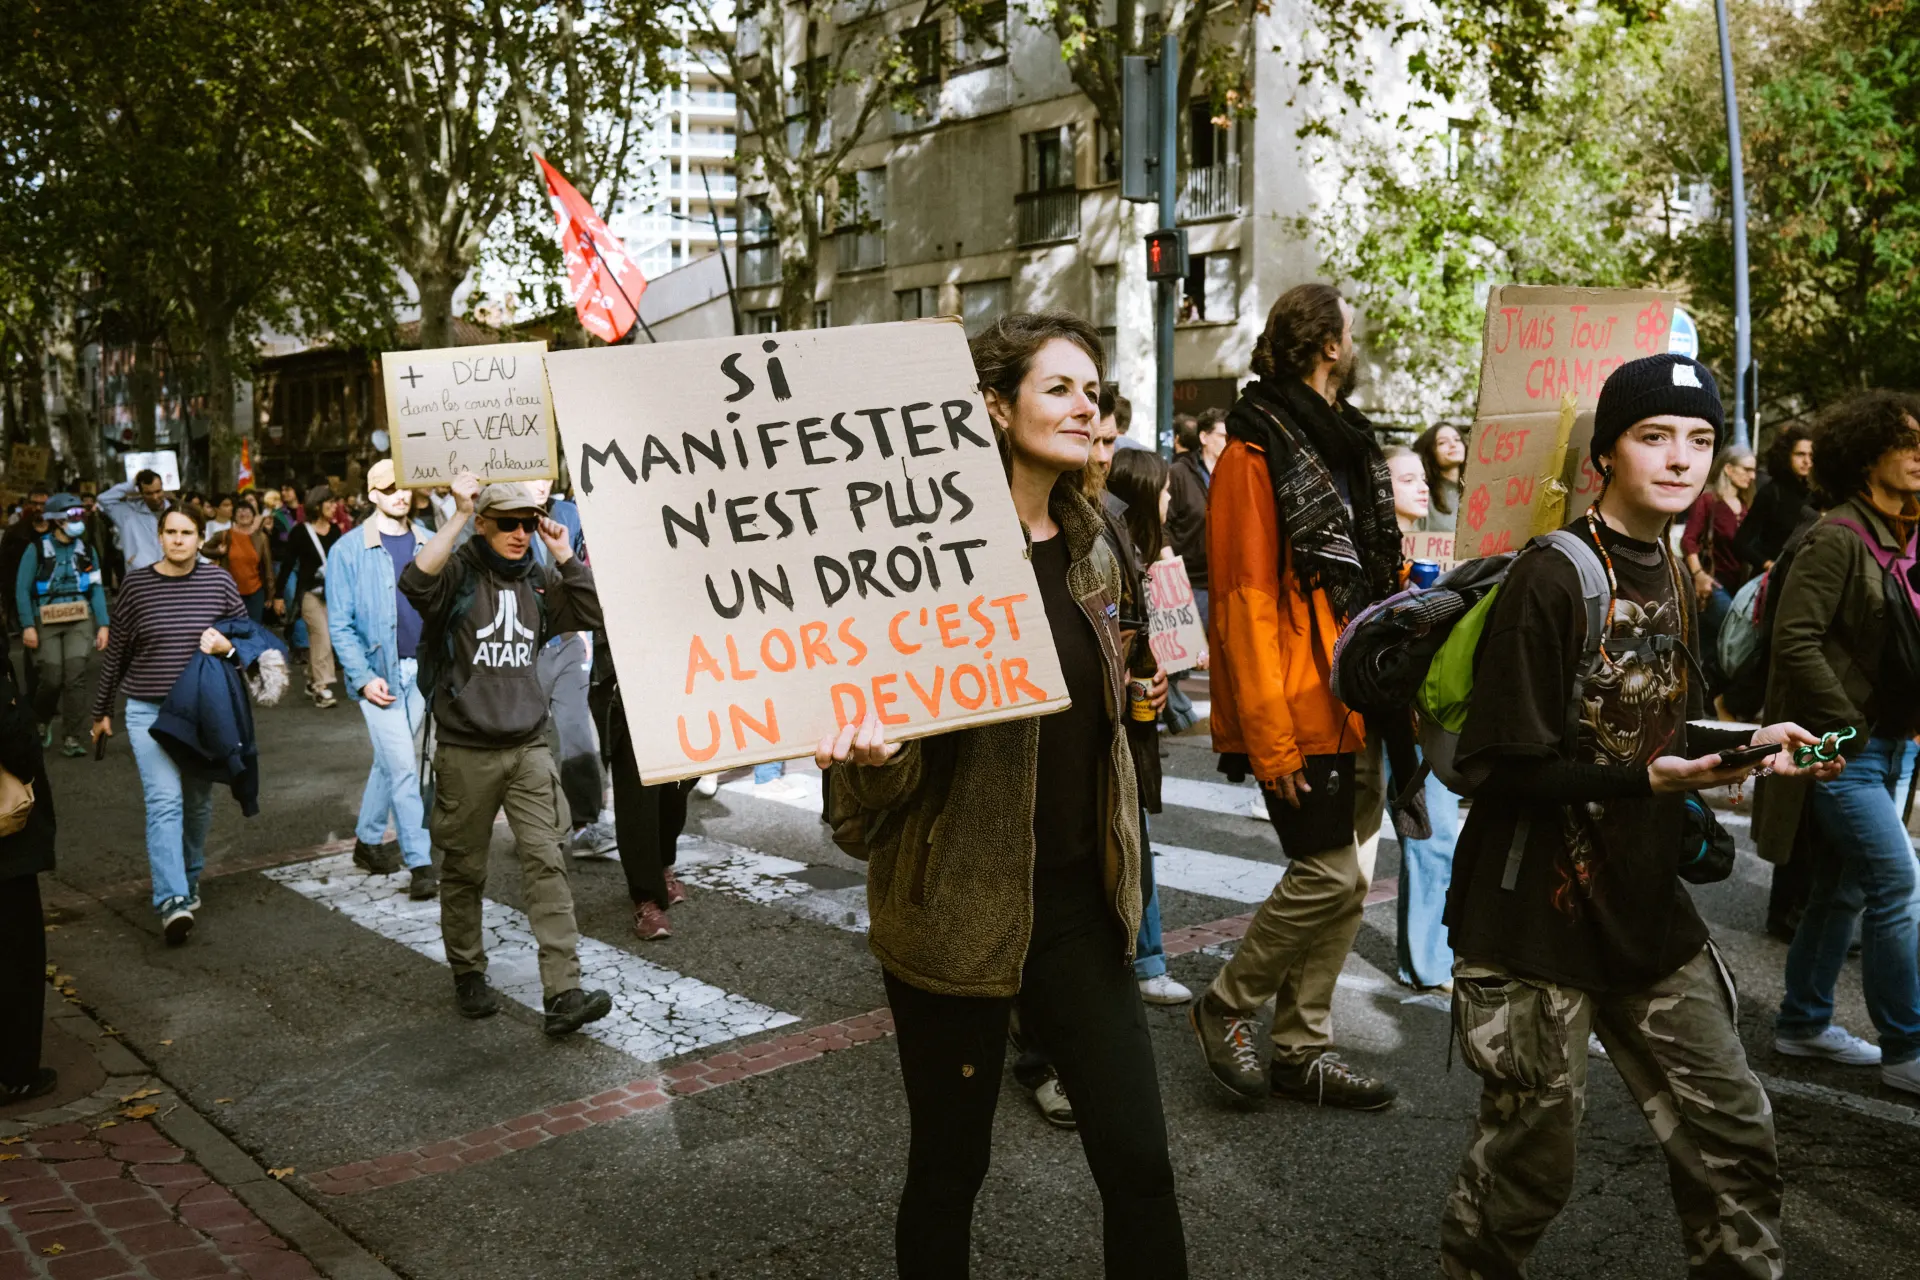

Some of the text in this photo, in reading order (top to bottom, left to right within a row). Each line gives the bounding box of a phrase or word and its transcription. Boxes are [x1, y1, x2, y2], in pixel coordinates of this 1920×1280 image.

[452, 356, 516, 385] D'EAU
[400, 388, 541, 417] dans les cours d'eau
[442, 418, 469, 441] DE
[474, 412, 539, 440] VEAUX
[1477, 424, 1531, 465] C'EST
[412, 448, 549, 479] sur les plateaux
[1505, 475, 1535, 508] DU
[661, 470, 974, 549] N'EST PLUS
[1426, 536, 1456, 557] PRE
[704, 563, 795, 620] UN
[684, 594, 1029, 696] ALORS C'EST
[677, 698, 781, 763] UN
